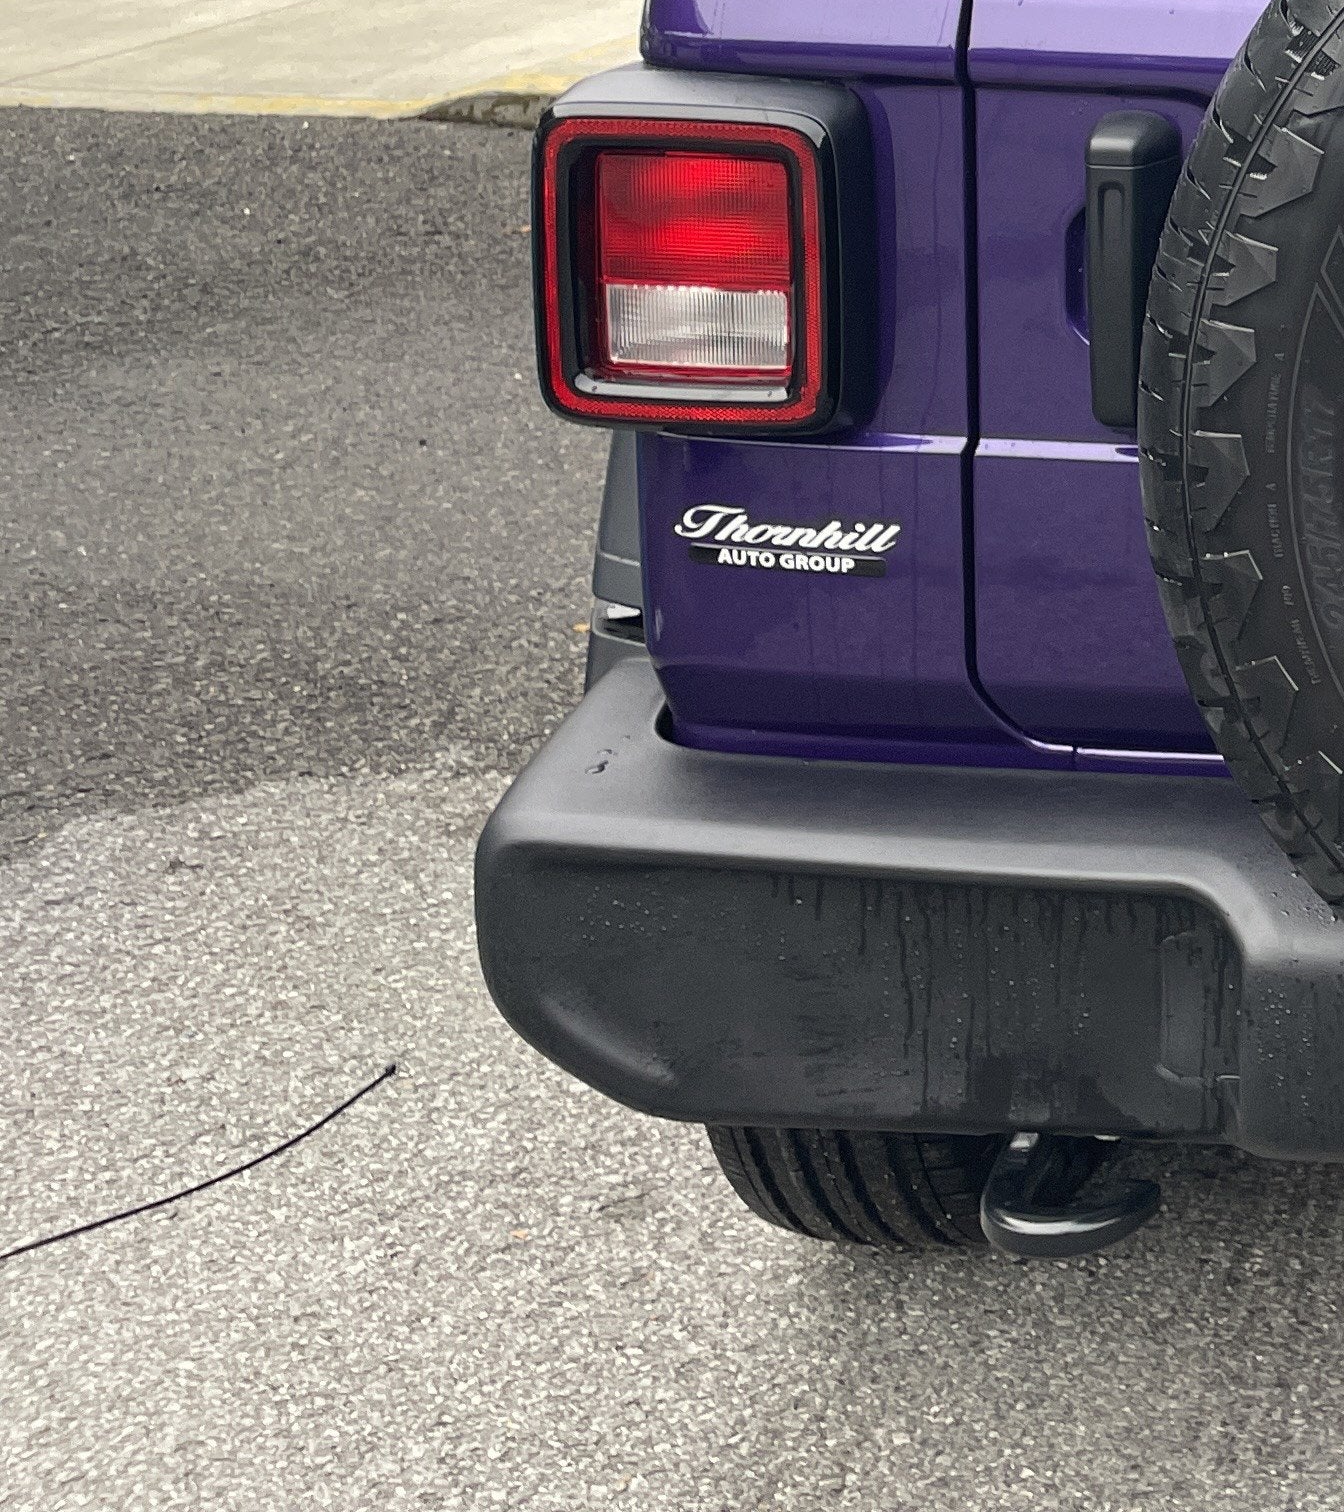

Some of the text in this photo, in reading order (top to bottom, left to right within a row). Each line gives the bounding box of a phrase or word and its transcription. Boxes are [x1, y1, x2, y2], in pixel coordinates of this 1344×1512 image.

[674, 504, 901, 553] Thornhill
[717, 548, 855, 573] AUTO GROUP
